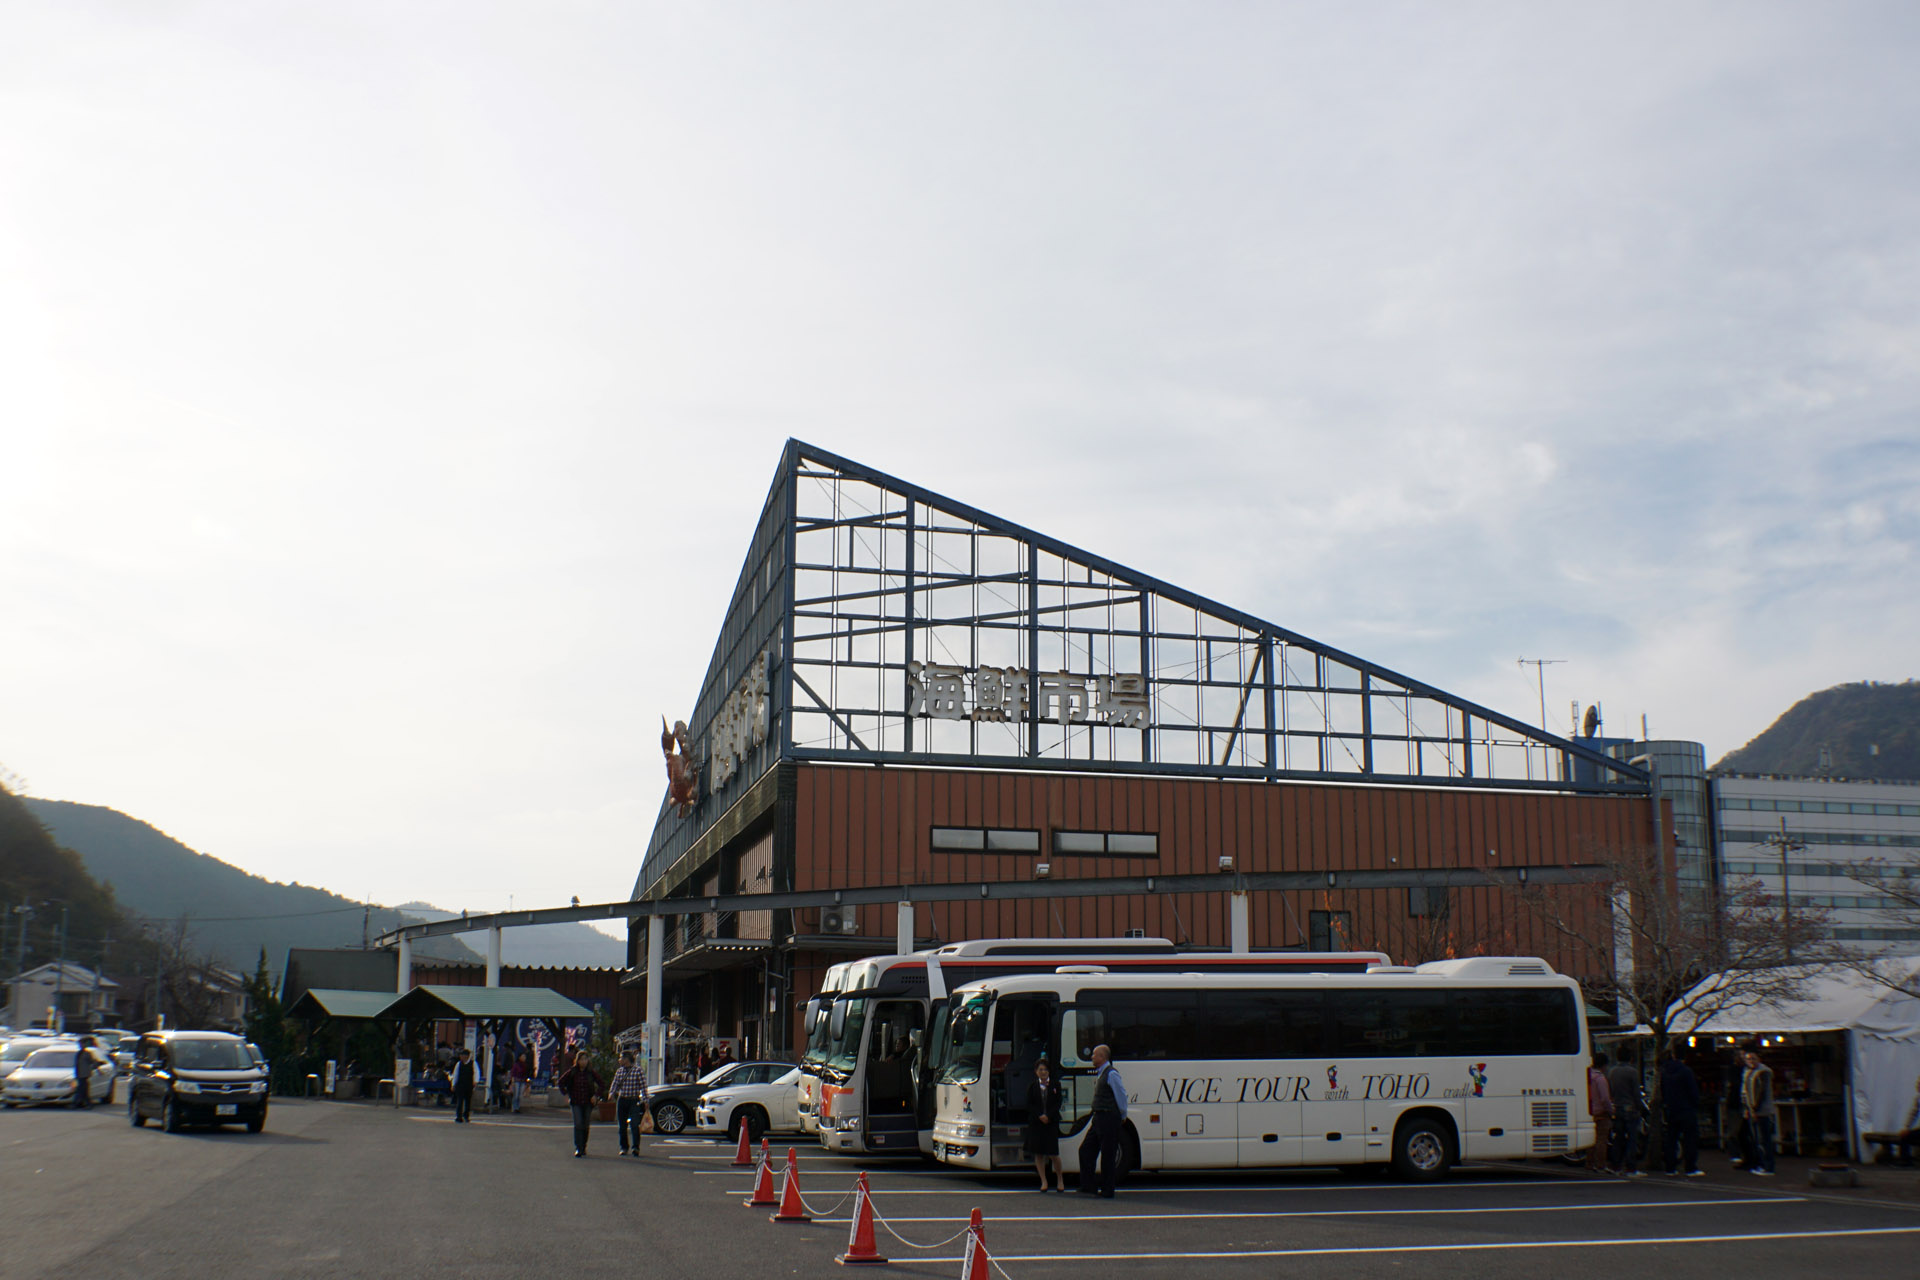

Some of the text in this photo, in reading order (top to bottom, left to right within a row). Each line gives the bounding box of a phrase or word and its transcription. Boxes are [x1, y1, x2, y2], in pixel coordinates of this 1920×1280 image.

[907, 660, 1151, 729] 海鮮市場
[1154, 1077, 1222, 1103] NICE
[1236, 1076, 1311, 1102] TOUR
[1324, 1085, 1349, 1100] with
[1443, 1082, 1474, 1098] cradle
